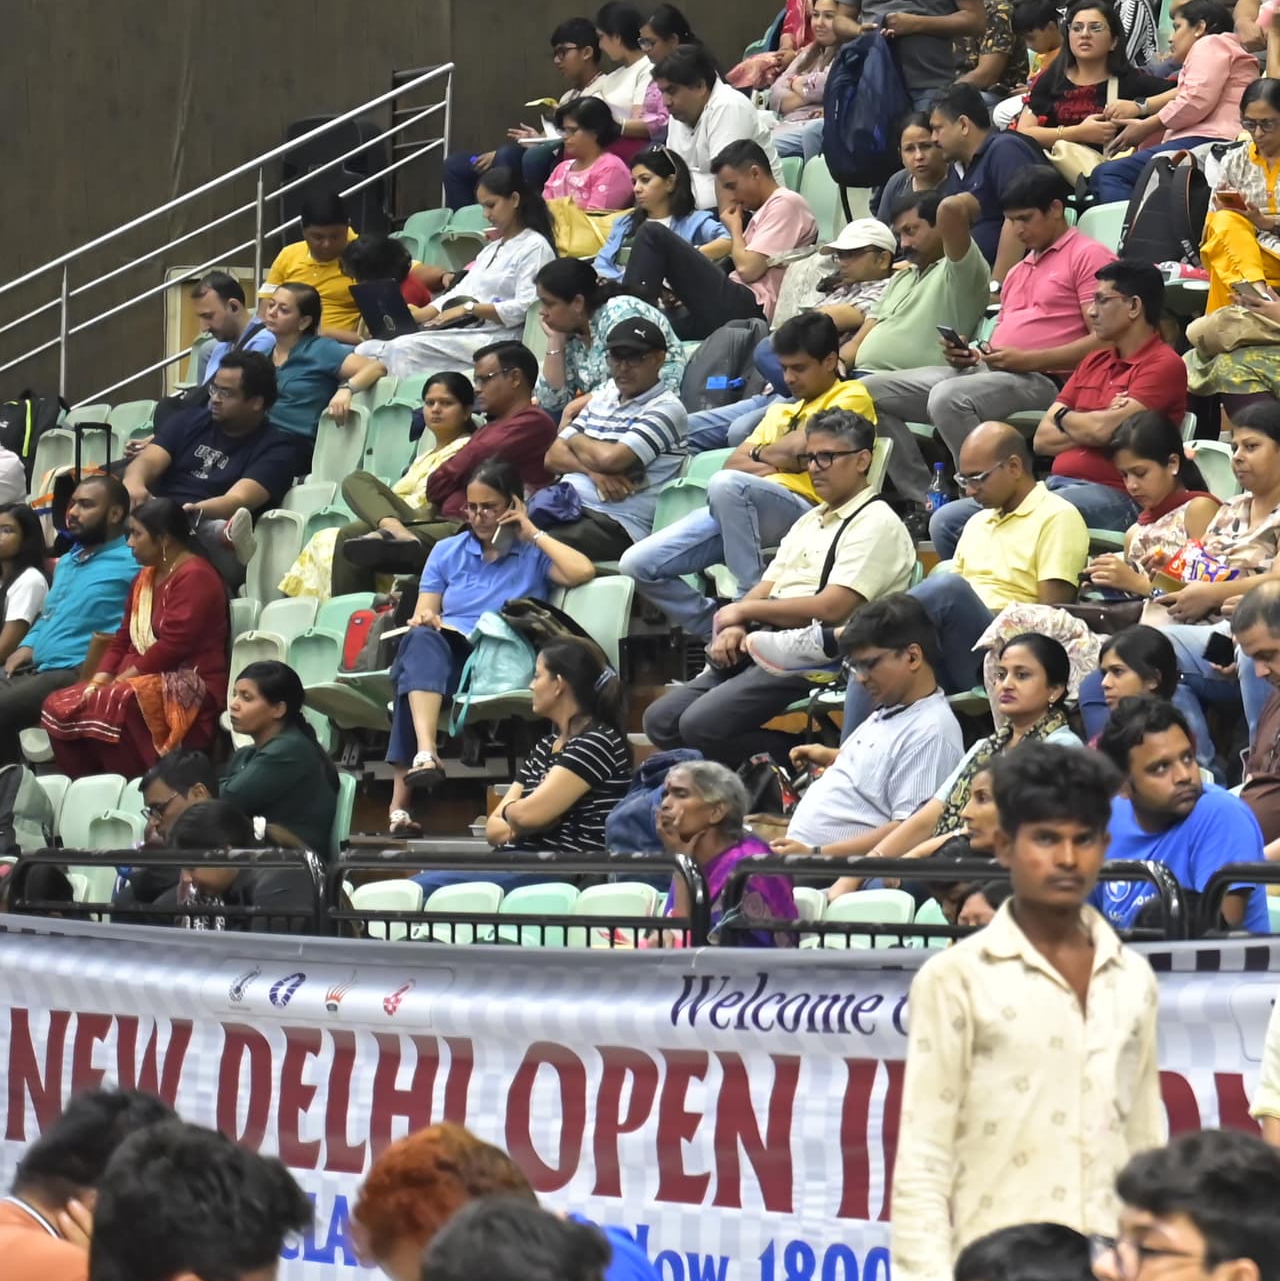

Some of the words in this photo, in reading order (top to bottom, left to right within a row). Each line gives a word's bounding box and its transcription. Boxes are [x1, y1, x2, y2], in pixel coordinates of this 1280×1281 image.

[670, 972, 884, 1035] Welcome
[5, 1007, 194, 1142] NEW
[216, 1021, 475, 1174] DELHI
[504, 1040, 801, 1213] OPEN
